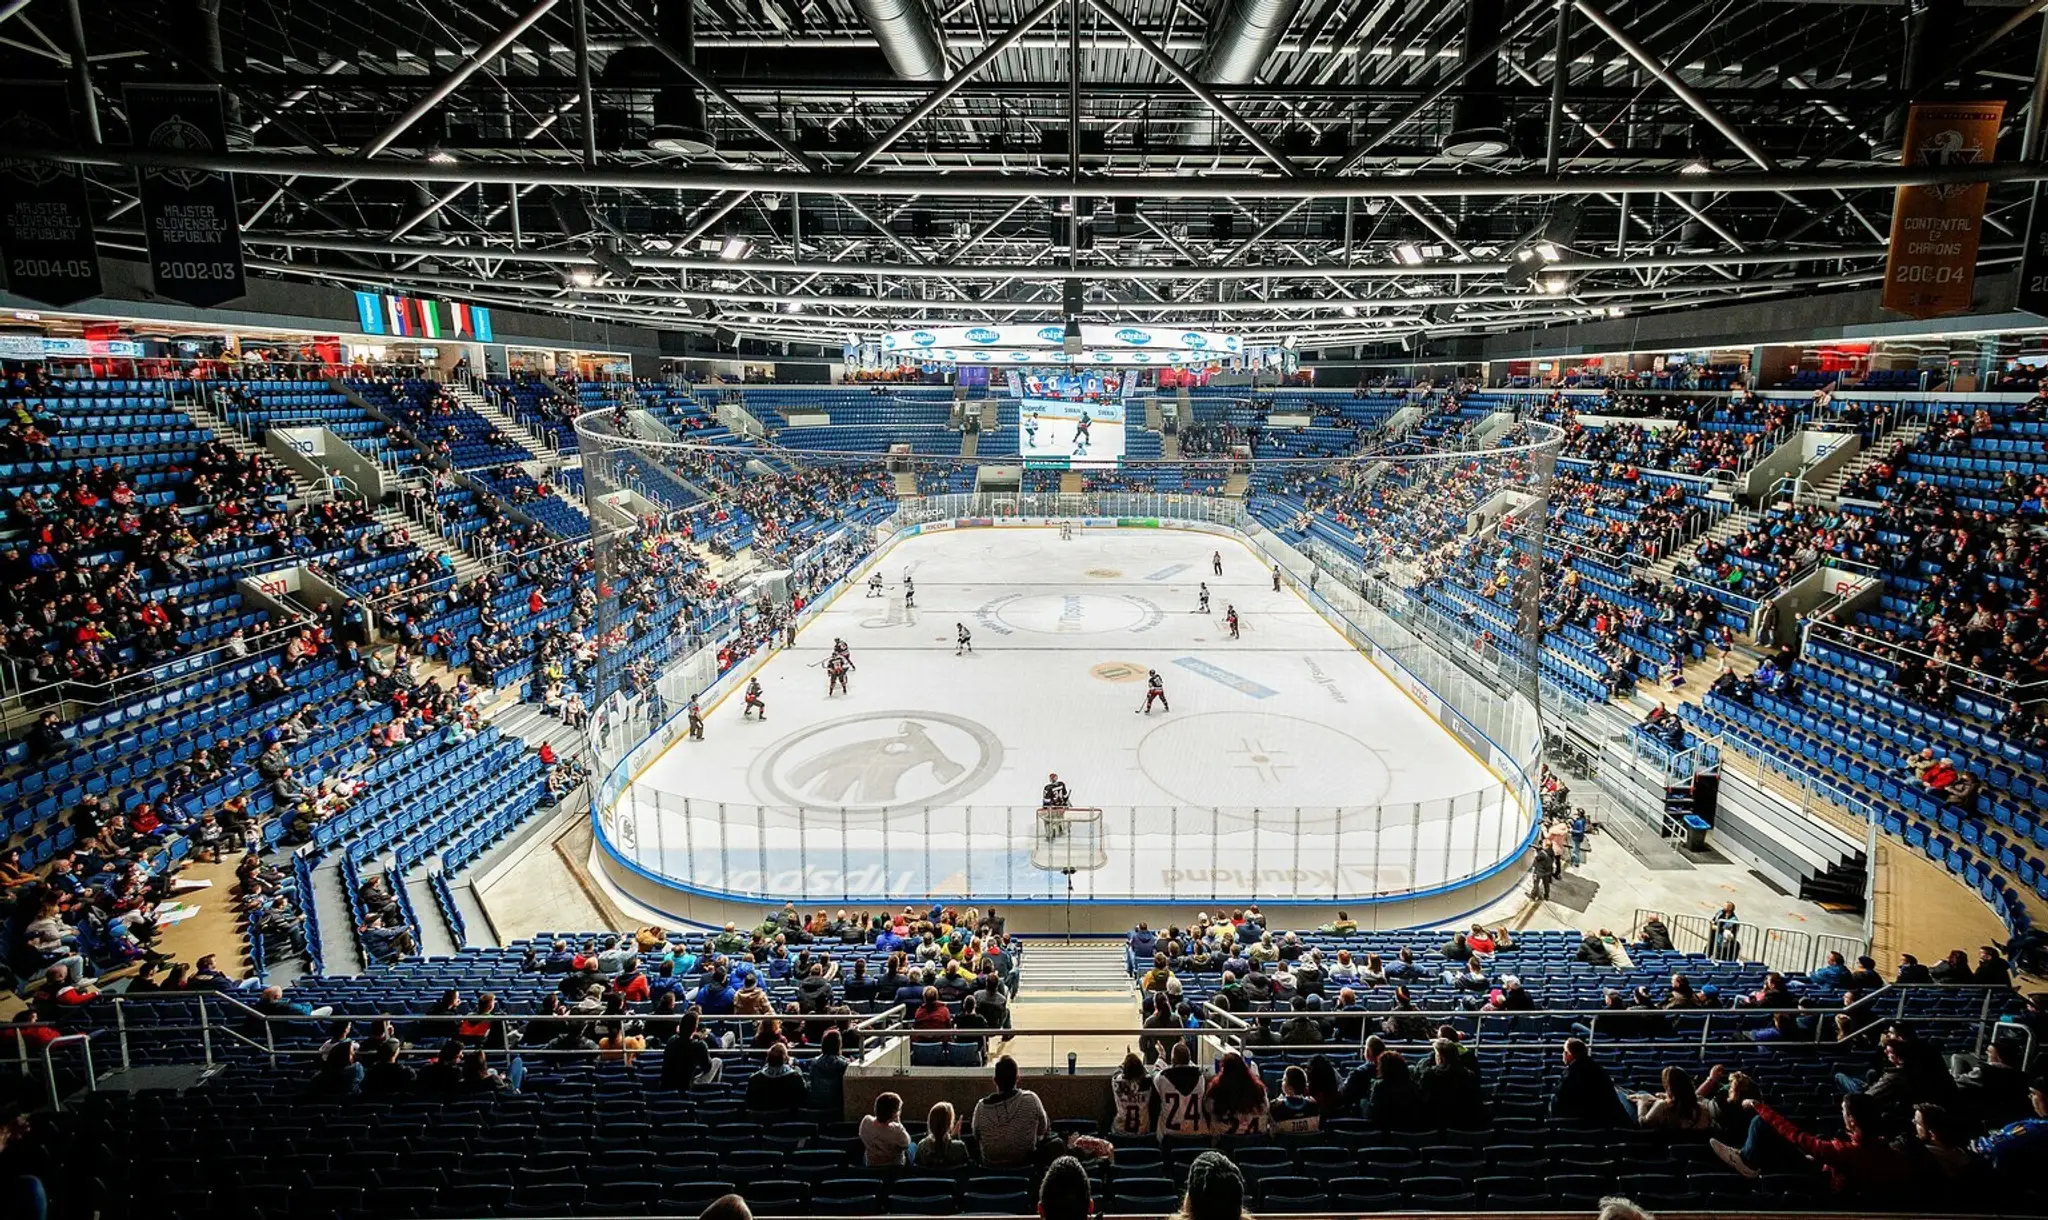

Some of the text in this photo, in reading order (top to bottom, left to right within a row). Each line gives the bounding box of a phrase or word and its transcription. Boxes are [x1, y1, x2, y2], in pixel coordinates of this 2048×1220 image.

[15, 201, 68, 215] MAJSTER
[164, 205, 215, 218] MAJSTER
[7, 214, 82, 228] SLOVENSKEJ
[155, 217, 228, 231] SLOVENSKEJ
[15, 227, 76, 241] REPUBLIKY
[163, 230, 223, 243] REPUBLIKY
[13, 259, 91, 278] 2004-05
[160, 261, 236, 280] 2002-03
[967, 329, 1000, 341] dolphin
[1116, 330, 1151, 341] dolphin
[1048, 379, 1058, 390] 0
[1087, 379, 1097, 390] 0
[925, 522, 948, 531] RICOH
[1161, 869, 1333, 889] Kaufland
[1165, 1093, 1200, 1131] 24
